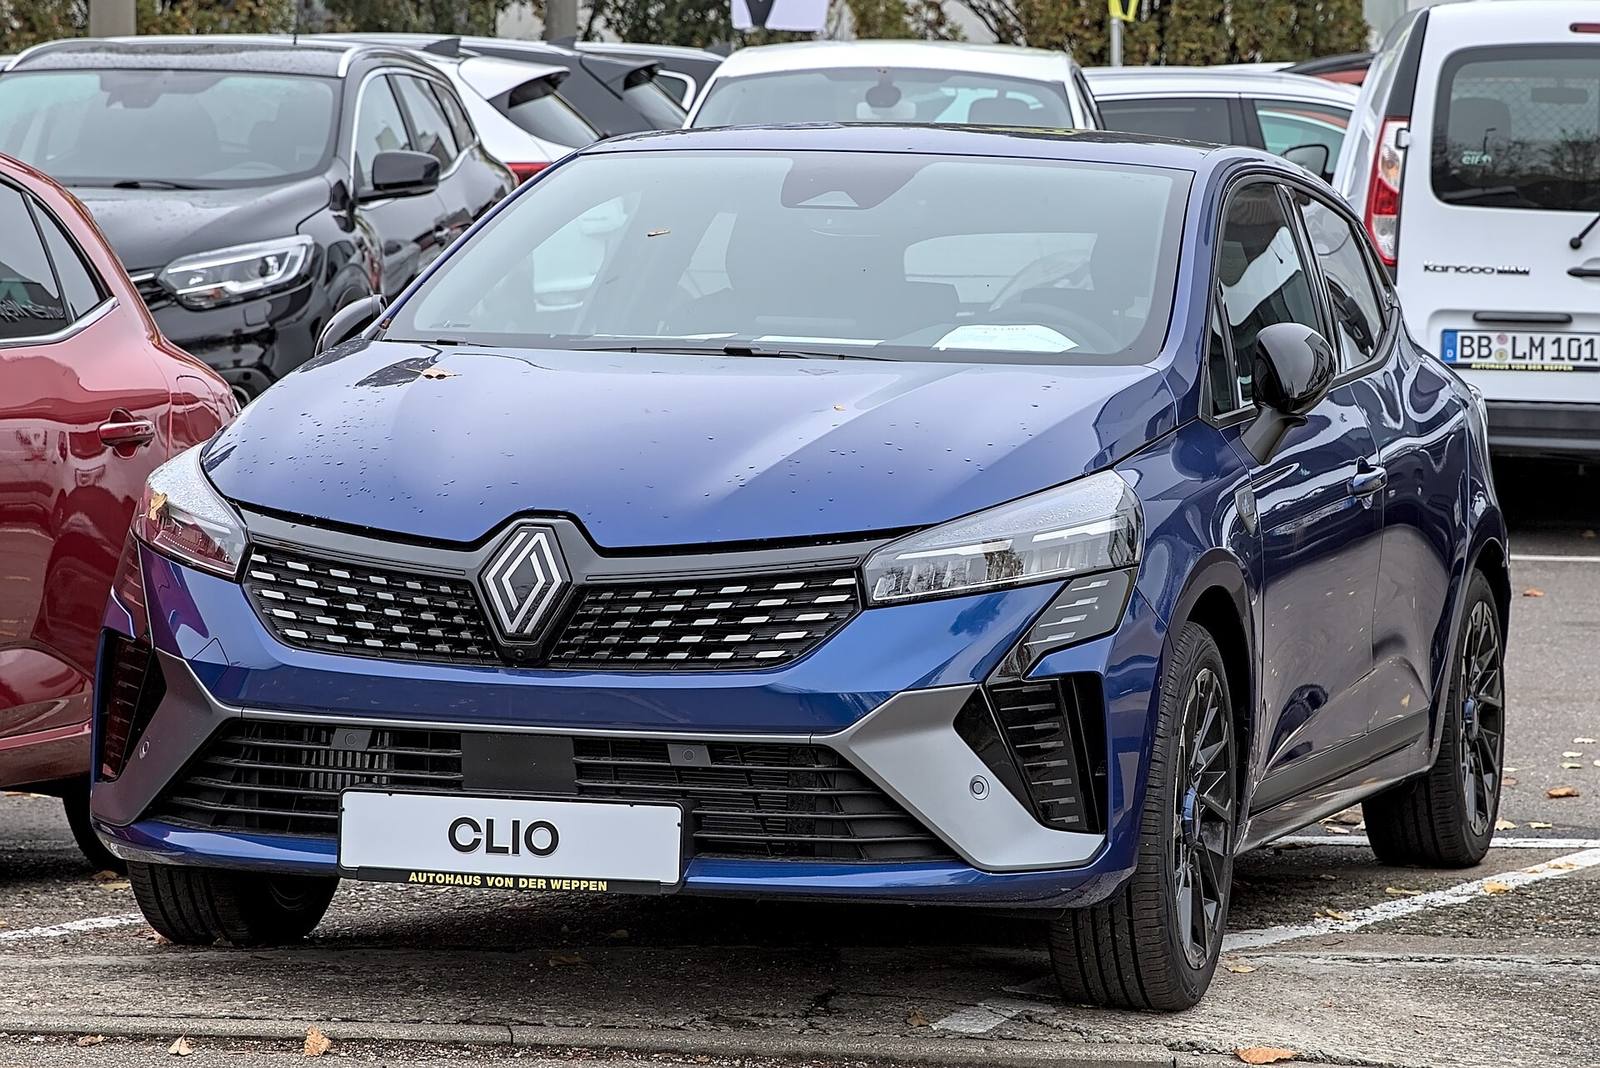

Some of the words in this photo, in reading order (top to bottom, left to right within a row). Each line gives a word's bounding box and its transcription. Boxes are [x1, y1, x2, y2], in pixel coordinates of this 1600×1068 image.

[1460, 336, 1492, 359] BB
[1511, 336, 1545, 361] LM
[1551, 337, 1598, 362] 101
[448, 816, 560, 856] CLIO
[408, 871, 482, 886] AUTOHAUS
[486, 876, 514, 888] VON
[518, 877, 547, 889] DER
[550, 879, 608, 892] WEPPEN
